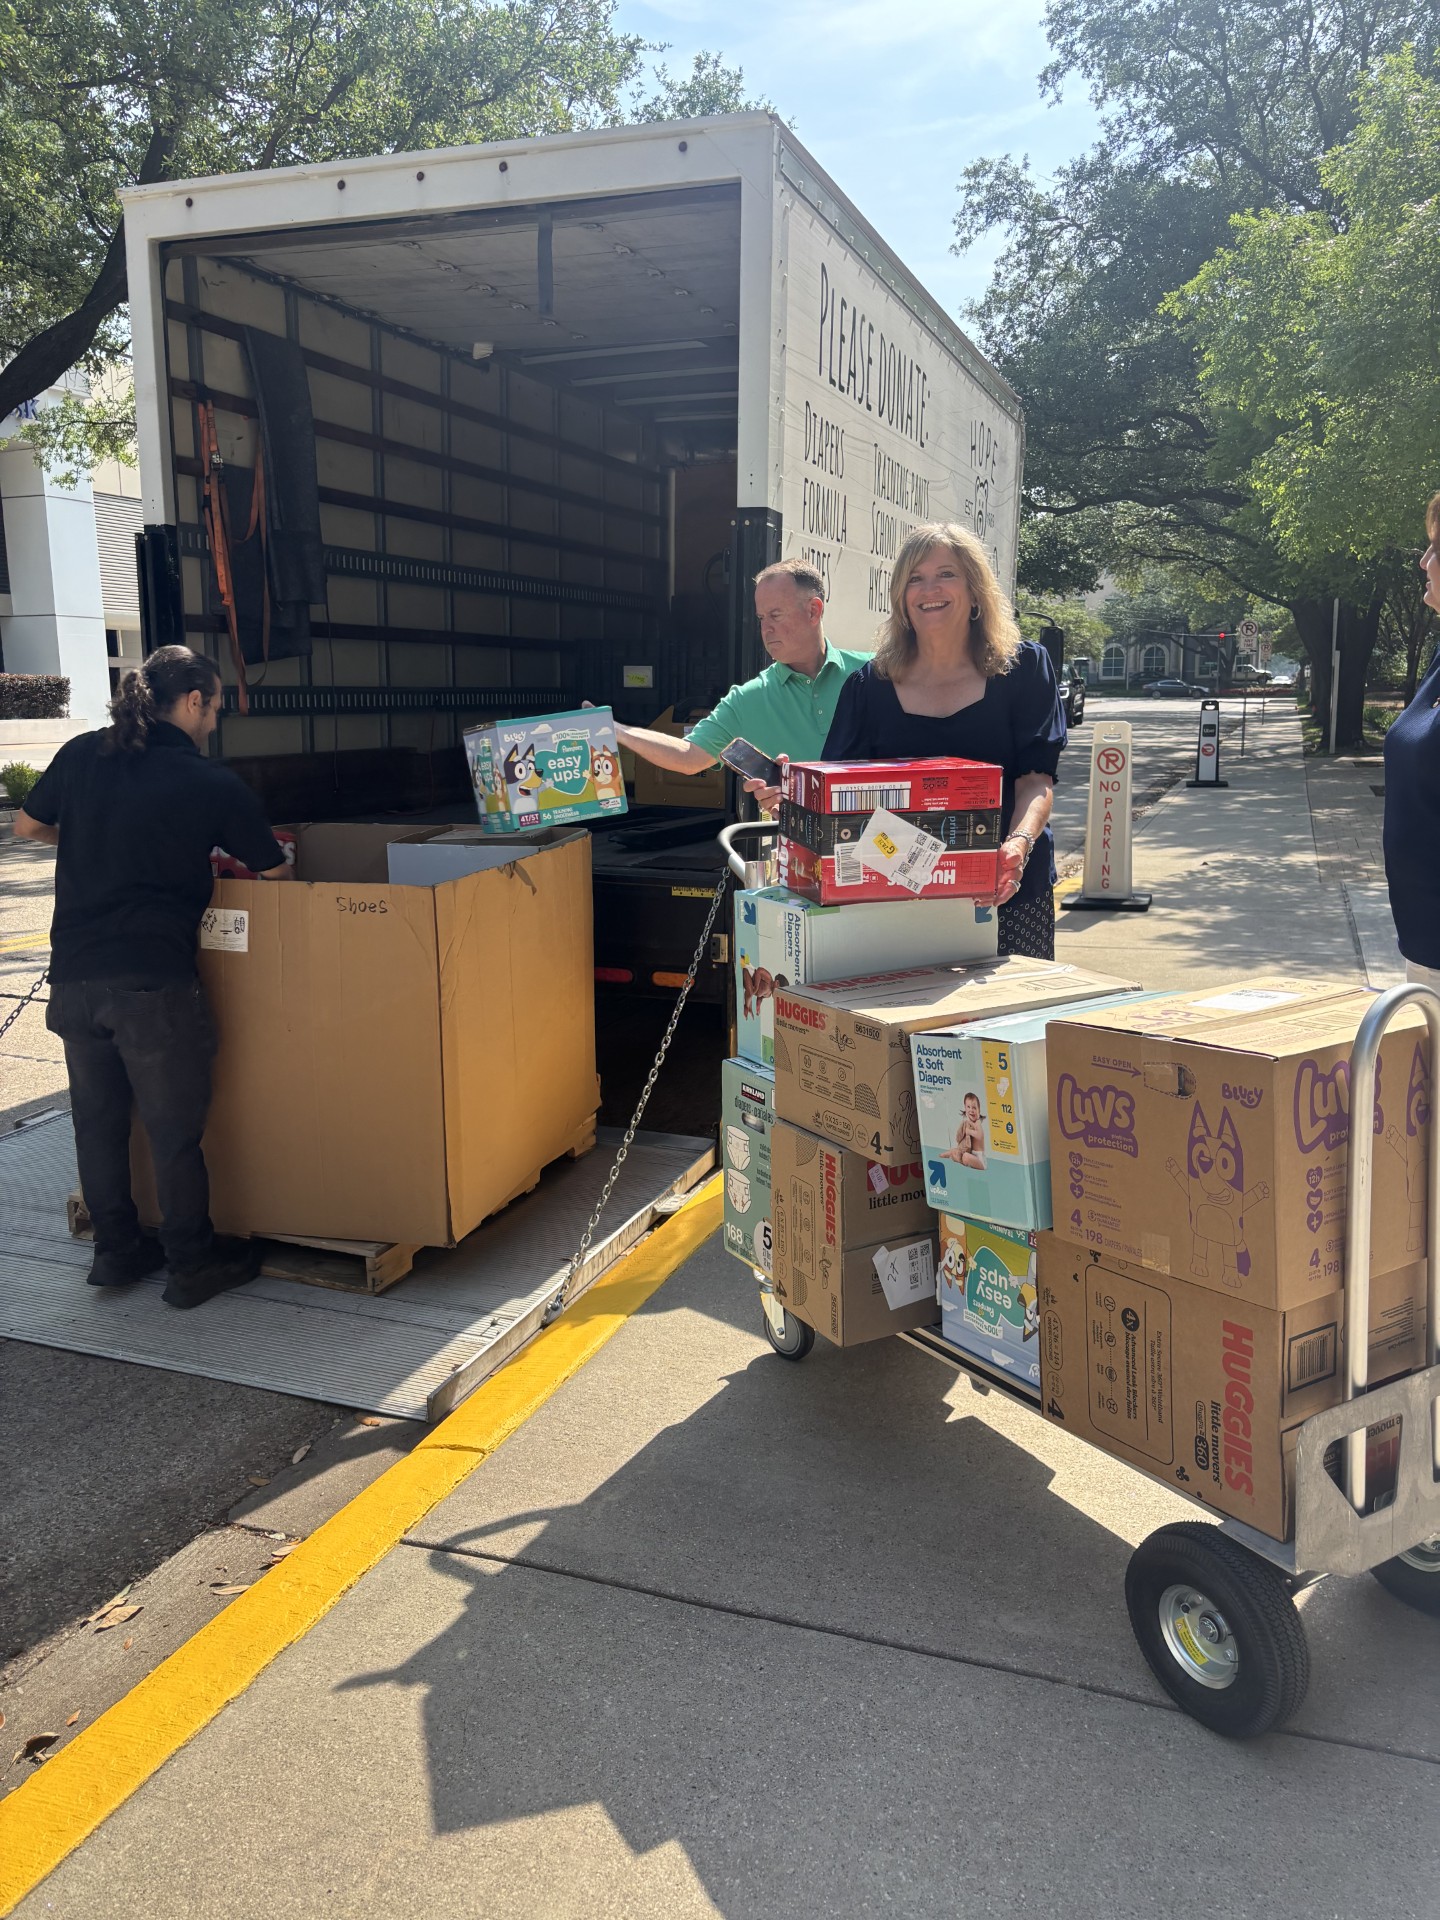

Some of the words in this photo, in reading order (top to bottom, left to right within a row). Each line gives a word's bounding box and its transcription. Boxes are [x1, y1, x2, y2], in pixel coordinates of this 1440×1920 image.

[819, 262, 874, 412] PLEASE
[878, 332, 931, 448] DONATE:
[804, 400, 845, 480] DIAPERS
[970, 419, 998, 486] HOPE
[872, 442, 910, 511] TRAINING
[910, 471, 930, 520] PANTS
[802, 477, 847, 545] FORMULA
[547, 755, 582, 770] easy
[553, 768, 581, 783] ups
[811, 774, 820, 790] 7
[1099, 780, 1121, 792] NO
[948, 816, 956, 845] prime
[887, 845, 896, 855] G
[1101, 797, 1113, 890] PARKING
[940, 860, 956, 868] little
[335, 896, 388, 914] Shoes
[794, 913, 802, 979] Absorbent
[806, 969, 935, 992] HUGGIES
[775, 996, 826, 1031] HUGGIES
[916, 1044, 962, 1060] Absorbent
[998, 1052, 1008, 1071] 5
[917, 1058, 924, 1069] &
[925, 1058, 945, 1072] Soft
[1093, 1055, 1111, 1065] EASY
[1112, 1058, 1132, 1069] OPEN
[918, 1070, 952, 1086] Diapers
[742, 1084, 765, 1100] KIRKLAND
[1001, 1103, 1013, 1114] 112
[870, 1131, 882, 1156] 4
[1088, 1134, 1134, 1152] protection
[1308, 1175, 1321, 1185] 12h
[825, 1153, 837, 1248] HUGGIES
[869, 1193, 899, 1210] little
[929, 1186, 948, 1197] up&up
[1070, 1208, 1083, 1227] 4
[725, 1221, 743, 1245] 168
[763, 1226, 772, 1250] 5
[989, 1224, 1014, 1238] TRAINING
[1016, 1231, 1026, 1240] 56
[1085, 1228, 1103, 1244] 198
[1309, 1247, 1321, 1268] 4
[1323, 1259, 1340, 1277] 198
[776, 1279, 788, 1298] 4
[979, 1266, 1008, 1291] ups
[976, 1282, 1012, 1310] easy
[972, 1299, 995, 1318] Pampers
[983, 1324, 999, 1336] 100%
[1125, 1310, 1136, 1329] 4x
[1123, 1331, 1132, 1359] blocage
[1130, 1333, 1138, 1370] Advanced
[1156, 1349, 1164, 1371] Secure
[1130, 1371, 1138, 1388] Leak
[1047, 1397, 1065, 1421] 4
[1131, 1389, 1139, 1420] Blockers
[1156, 1388, 1165, 1424] Waistband
[1222, 1320, 1255, 1497] HUGGIES
[1211, 1400, 1220, 1434] little
[1366, 1418, 1395, 1439] mover
[1197, 1437, 1207, 1468] 360
[1212, 1434, 1221, 1485] movers
